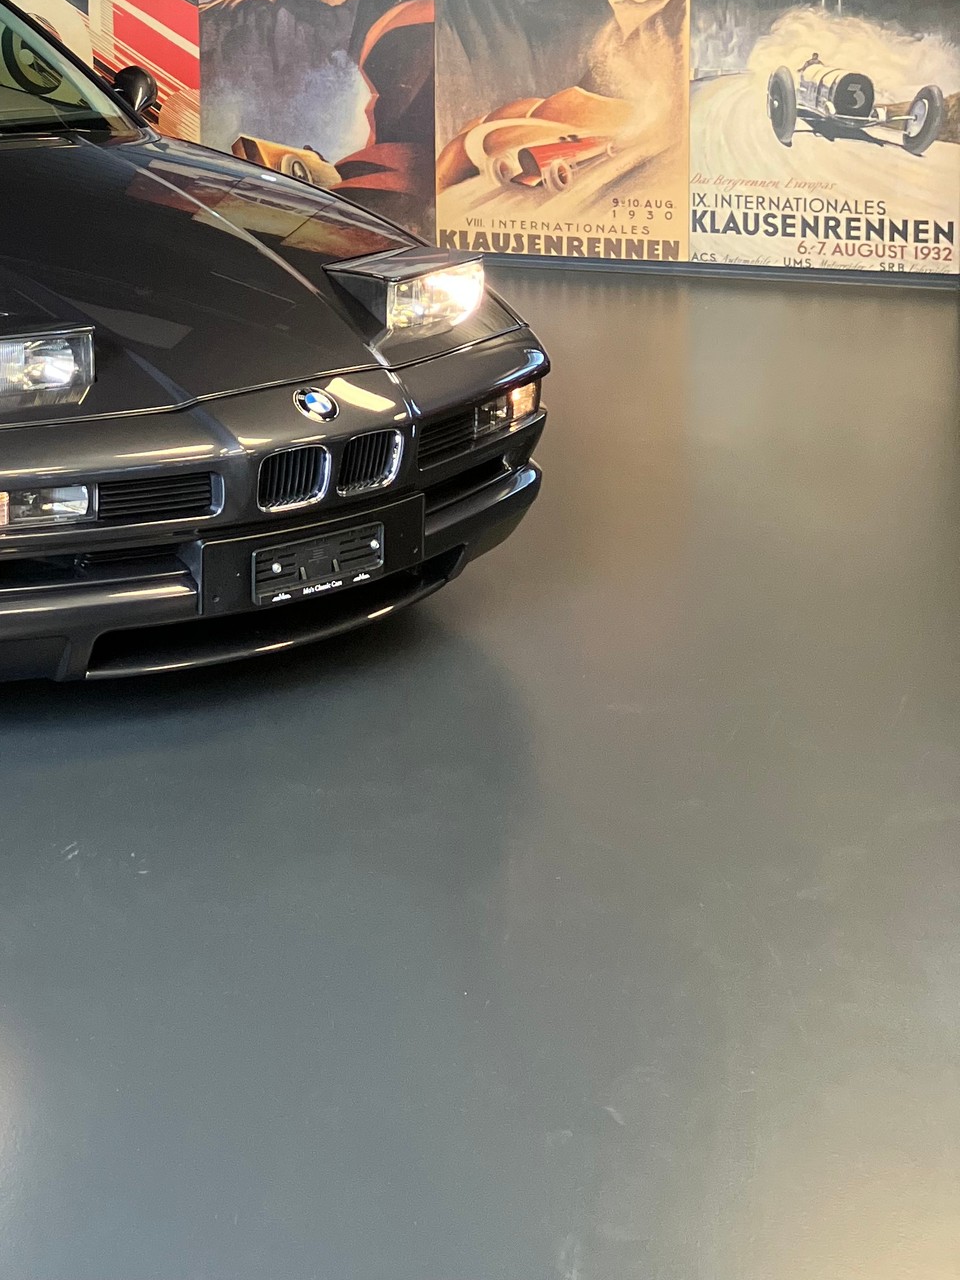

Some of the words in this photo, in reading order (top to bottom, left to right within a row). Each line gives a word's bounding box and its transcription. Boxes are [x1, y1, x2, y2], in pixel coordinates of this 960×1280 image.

[692, 192, 711, 208] IX.
[715, 193, 887, 216] INTERNATIONALES
[466, 217, 486, 227] VIII.
[491, 219, 650, 235] INTERNATIONALES
[691, 209, 954, 246] KLAUSENRENNEN
[439, 229, 680, 261] KLAUSENRENNEN
[831, 242, 908, 260] AUGUST
[914, 246, 953, 261] 1932
